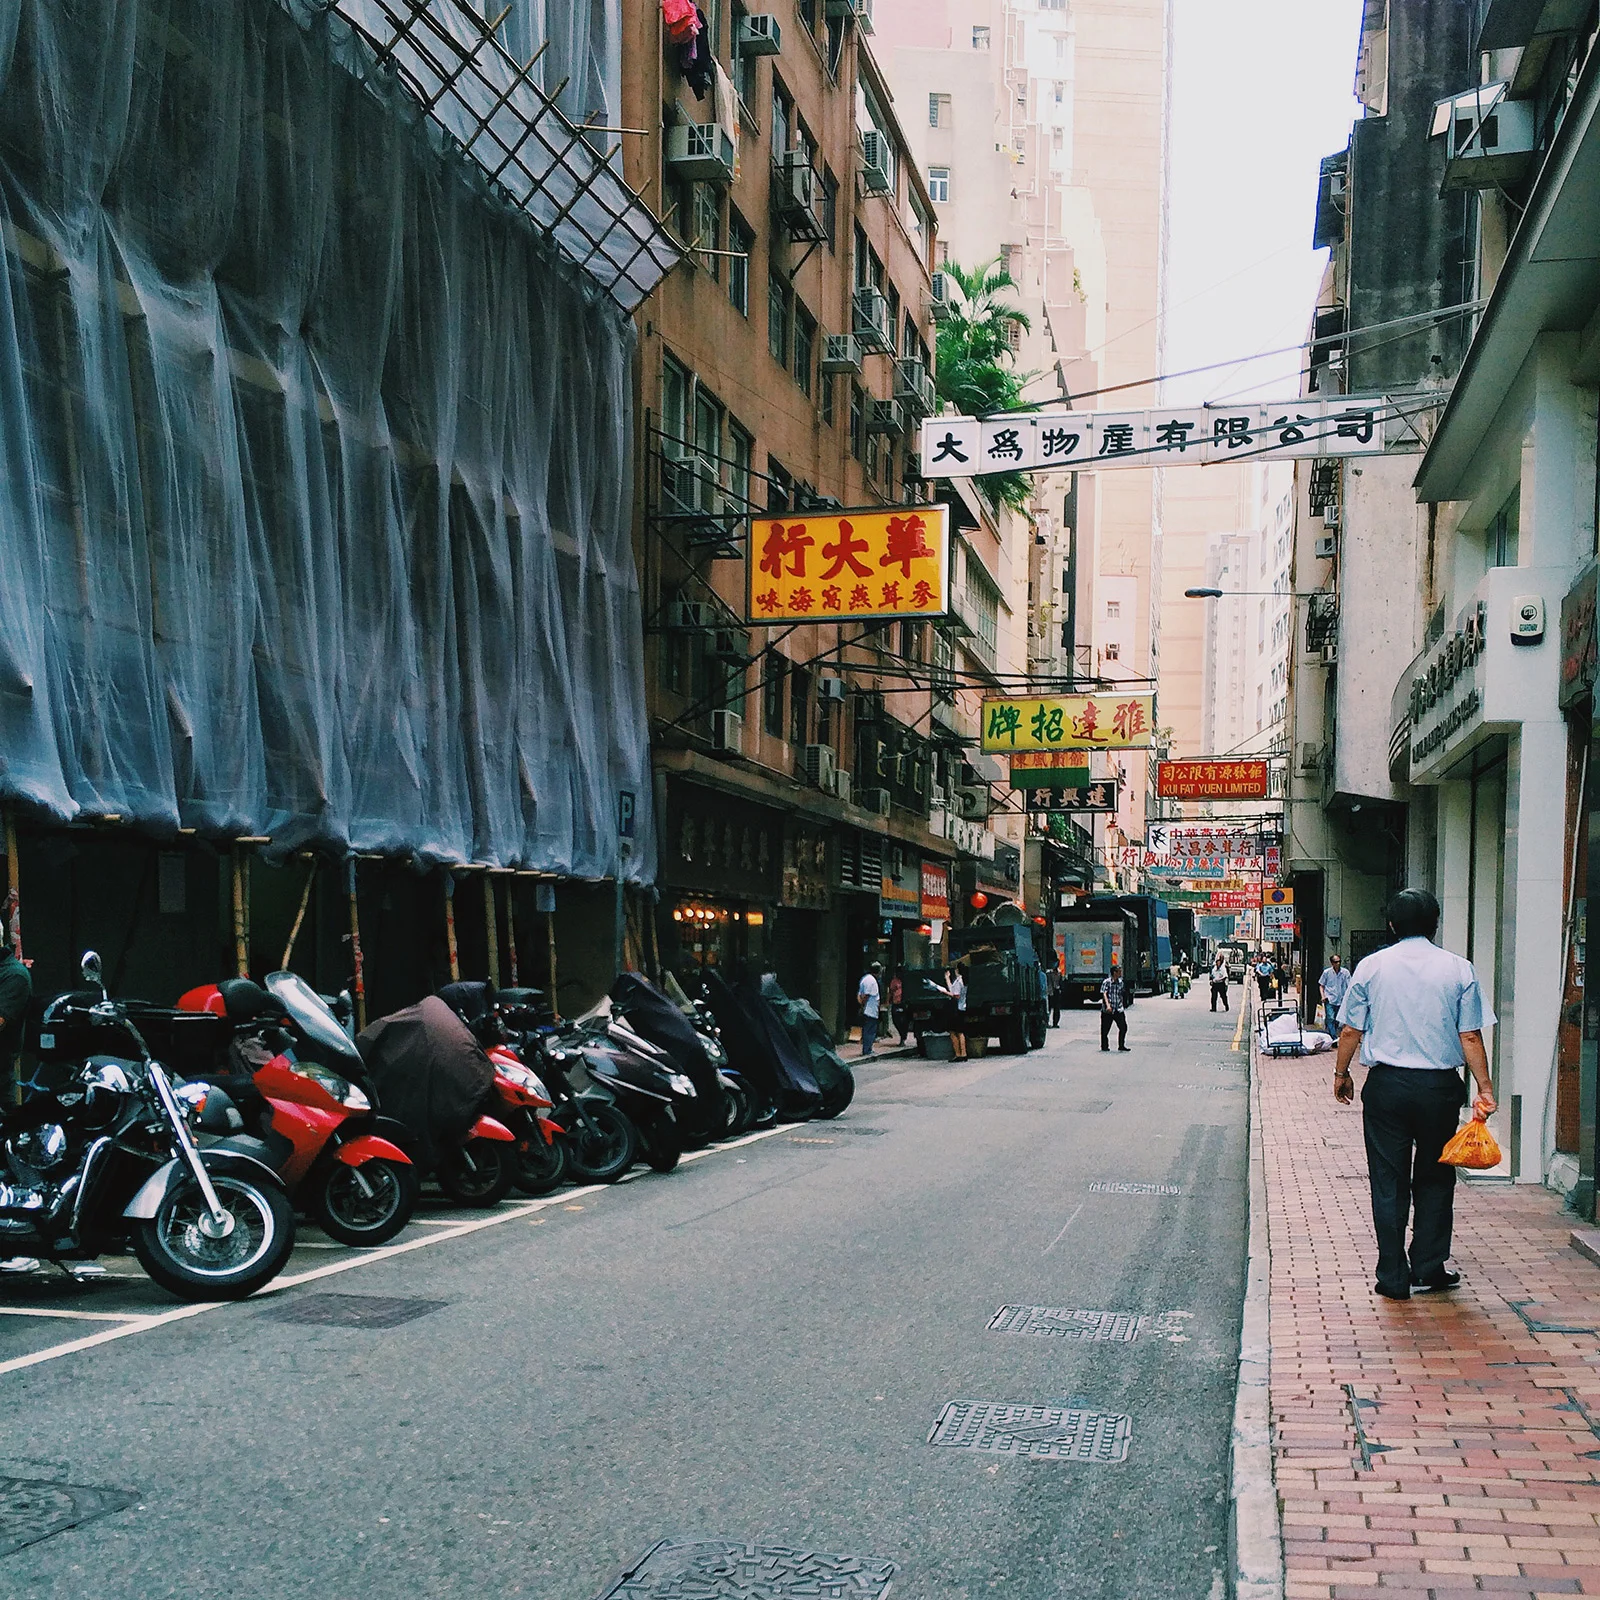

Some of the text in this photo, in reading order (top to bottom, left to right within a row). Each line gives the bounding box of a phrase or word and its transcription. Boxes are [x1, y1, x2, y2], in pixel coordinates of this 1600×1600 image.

[988, 700, 1149, 746] 雅達招牌
[1162, 764, 1263, 781] 鉅發源有限公司
[1163, 782, 1261, 794] KUI FAT YUEN LIMITED
[1172, 840, 1254, 857] 大昌參茸行
